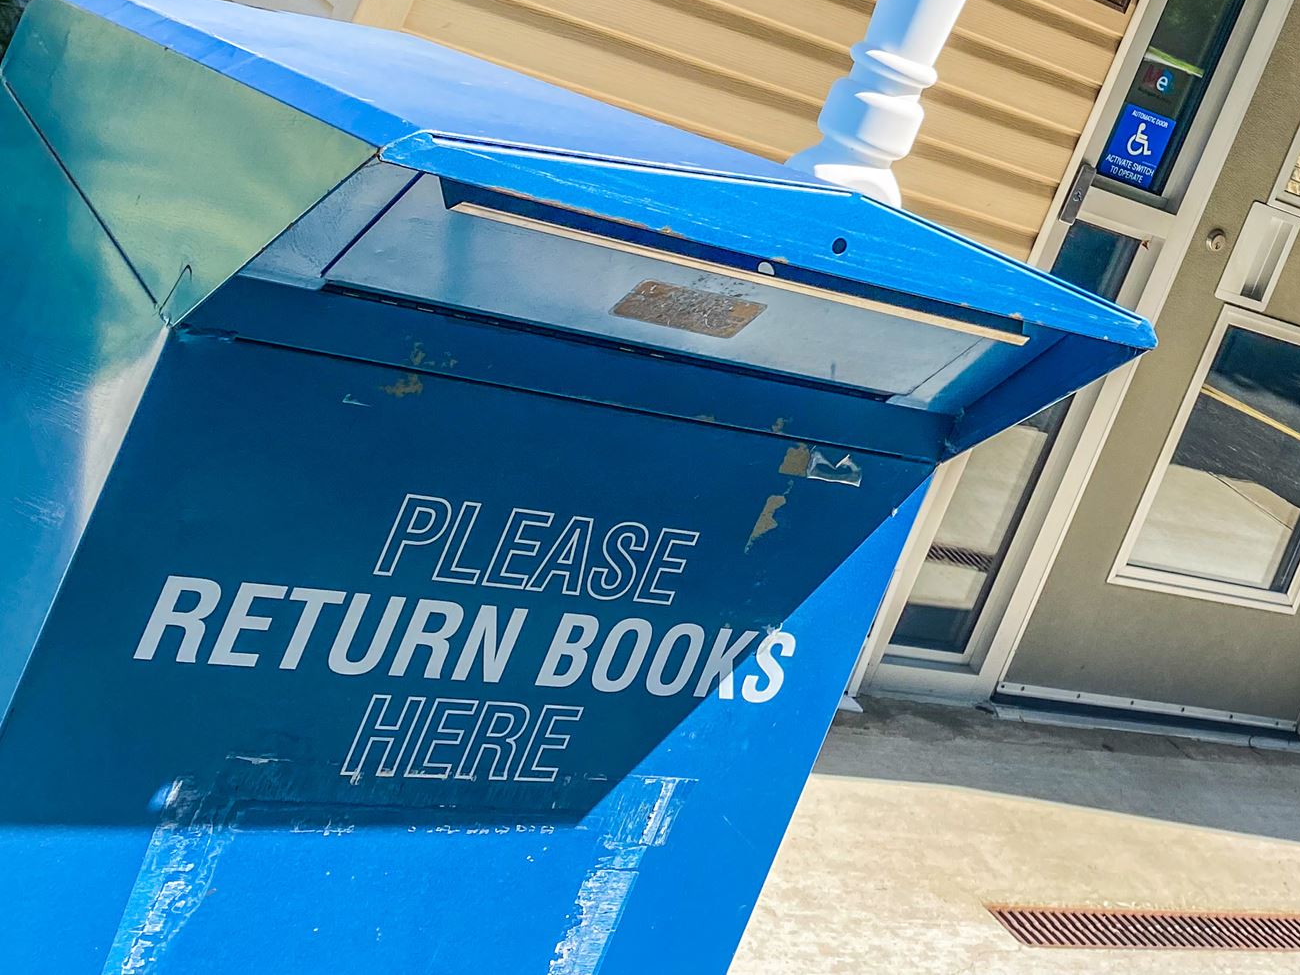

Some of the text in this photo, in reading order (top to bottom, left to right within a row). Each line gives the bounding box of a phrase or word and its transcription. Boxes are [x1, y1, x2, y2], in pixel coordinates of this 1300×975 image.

[1132, 110, 1169, 129] AUTOMATIC DOOR
[1105, 154, 1155, 177] ACTIVATE SWITCH
[1110, 165, 1144, 184] TO OPERATE
[372, 493, 700, 606] PLEASE
[132, 574, 797, 704] RETURN BOOKS
[339, 693, 585, 783] HERE
